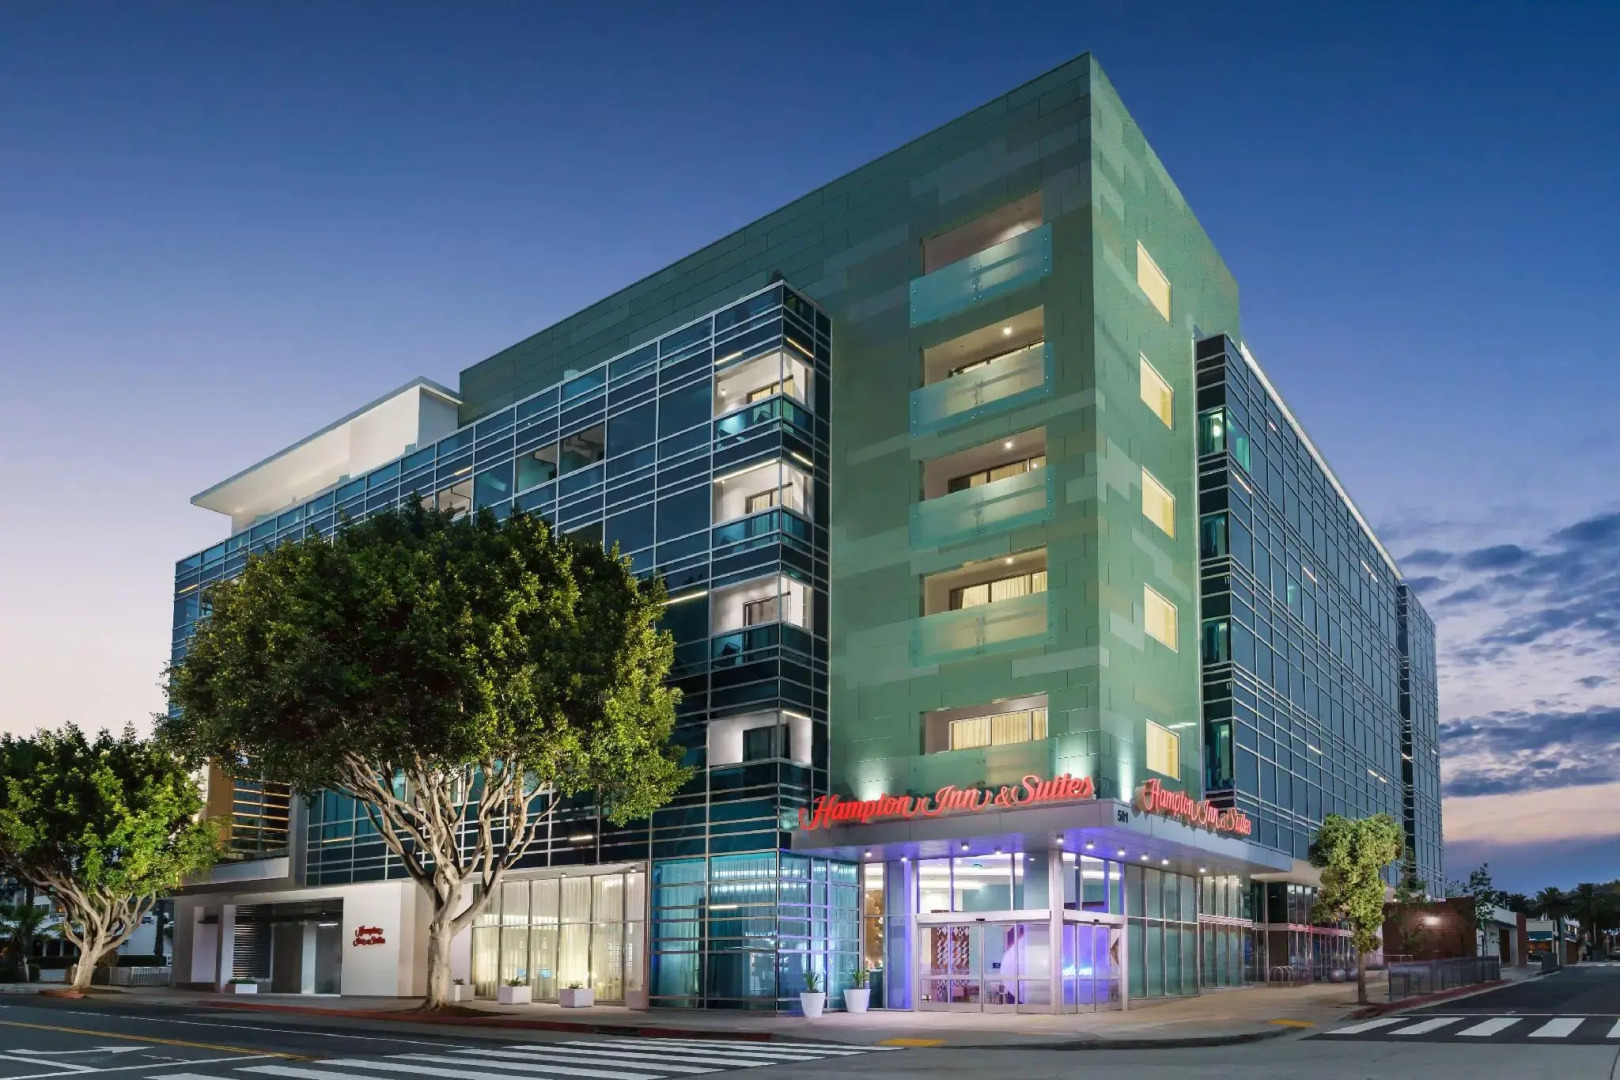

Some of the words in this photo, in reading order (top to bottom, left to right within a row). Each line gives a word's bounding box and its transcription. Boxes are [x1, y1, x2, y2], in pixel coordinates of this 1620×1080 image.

[799, 794, 921, 830] Hampton
[921, 785, 992, 816] Inn
[995, 786, 1011, 808] &
[1011, 773, 1095, 805] Suites
[1142, 778, 1200, 821] Hampton
